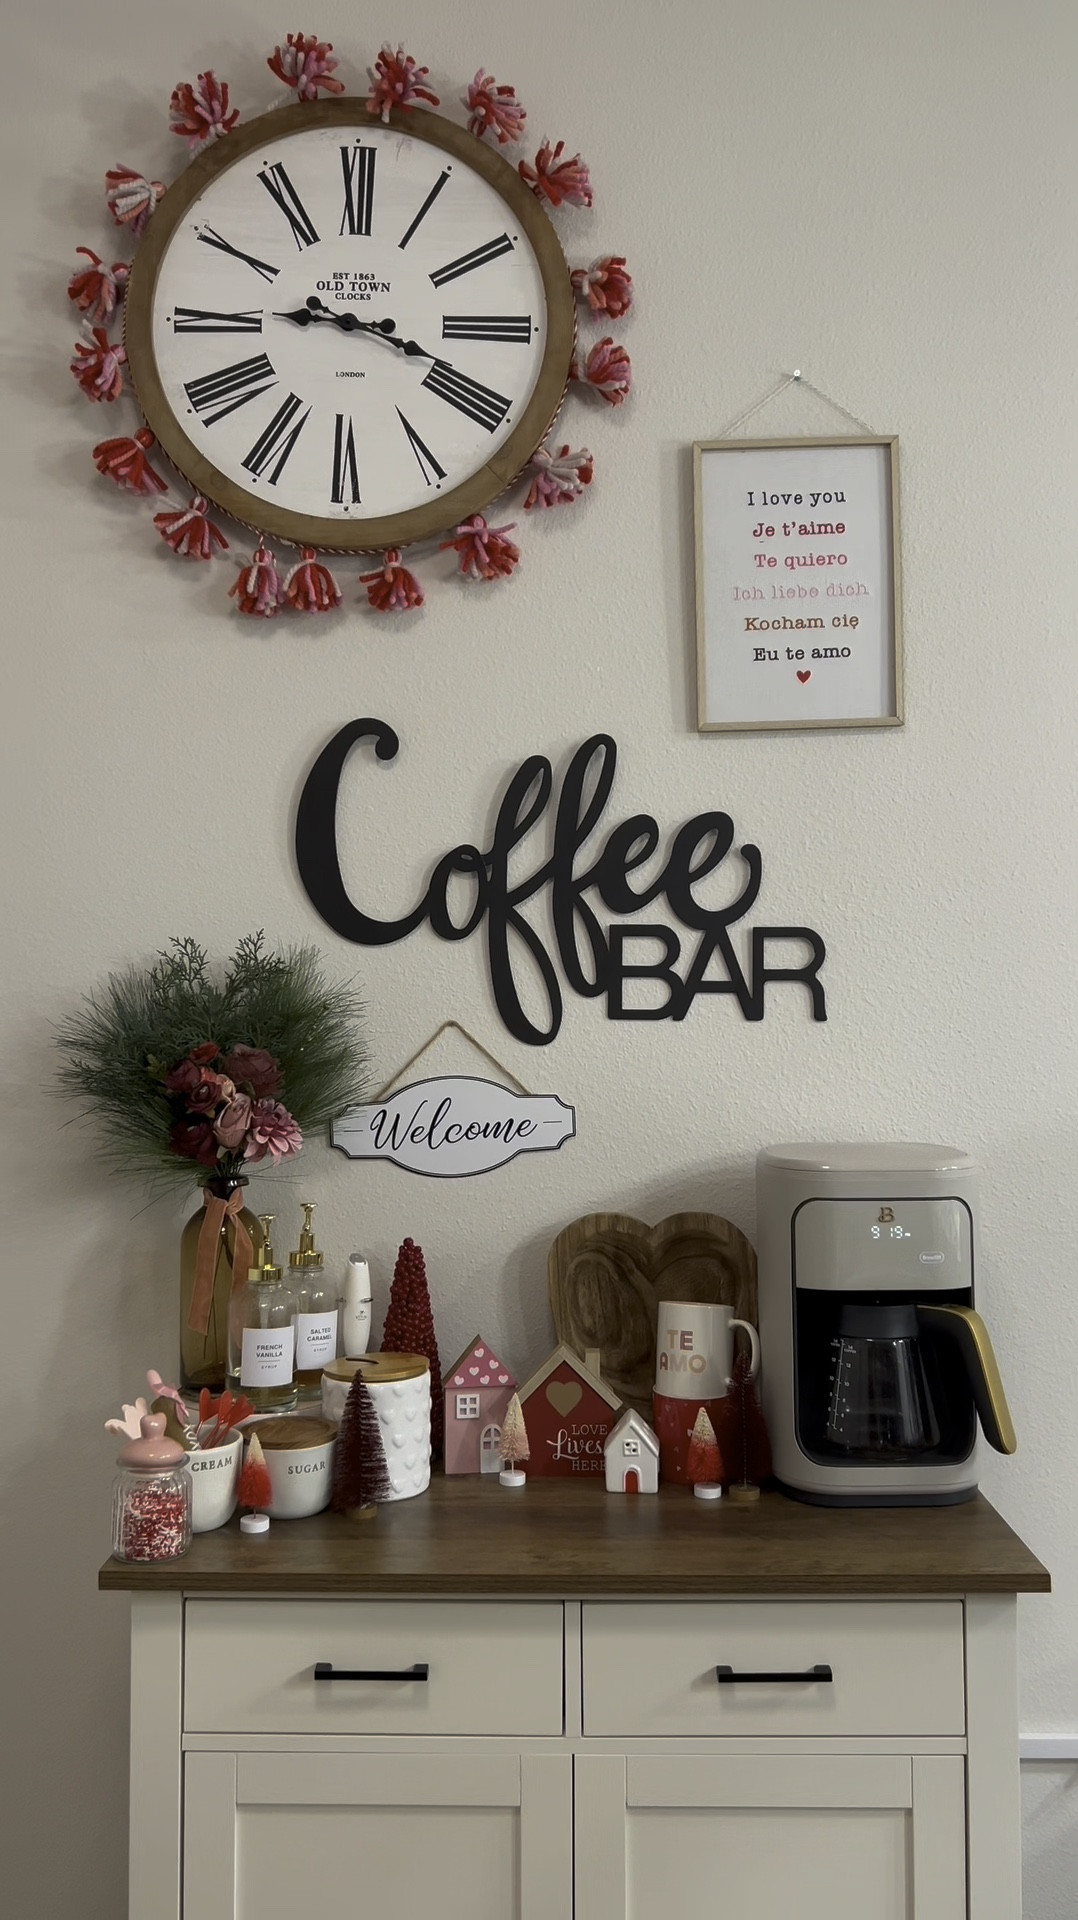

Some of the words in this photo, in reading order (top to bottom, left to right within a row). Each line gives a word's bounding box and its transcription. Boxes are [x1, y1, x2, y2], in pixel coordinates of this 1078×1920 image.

[340, 146, 377, 236] XII
[332, 272, 350, 280] EST
[316, 281, 344, 291] OLD
[349, 281, 391, 292] TOWN
[747, 491, 755, 506] I
[762, 491, 803, 506] love
[809, 490, 846, 508] you
[752, 522, 775, 537] Je
[754, 554, 777, 568] Te
[784, 552, 848, 570] quiero
[733, 587, 764, 601] Ich
[772, 585, 819, 600] liebe
[826, 583, 869, 597] dich
[744, 615, 826, 632] Kocham
[832, 614, 860, 630] cię
[753, 647, 779, 662] Eu
[785, 647, 805, 660] te
[811, 646, 851, 660] amo
[295, 717, 762, 1046] Coffee
[607, 924, 828, 1022] BAR
[369, 1096, 539, 1151] Welcome
[306, 1334, 332, 1342] CARAMEL
[666, 1329, 694, 1351] TE
[659, 1351, 707, 1374] AMO
[571, 1424, 608, 1435] LOVE
[546, 1428, 603, 1460] Lives
[191, 1455, 233, 1472] CREAM
[287, 1460, 326, 1475] SUGAR
